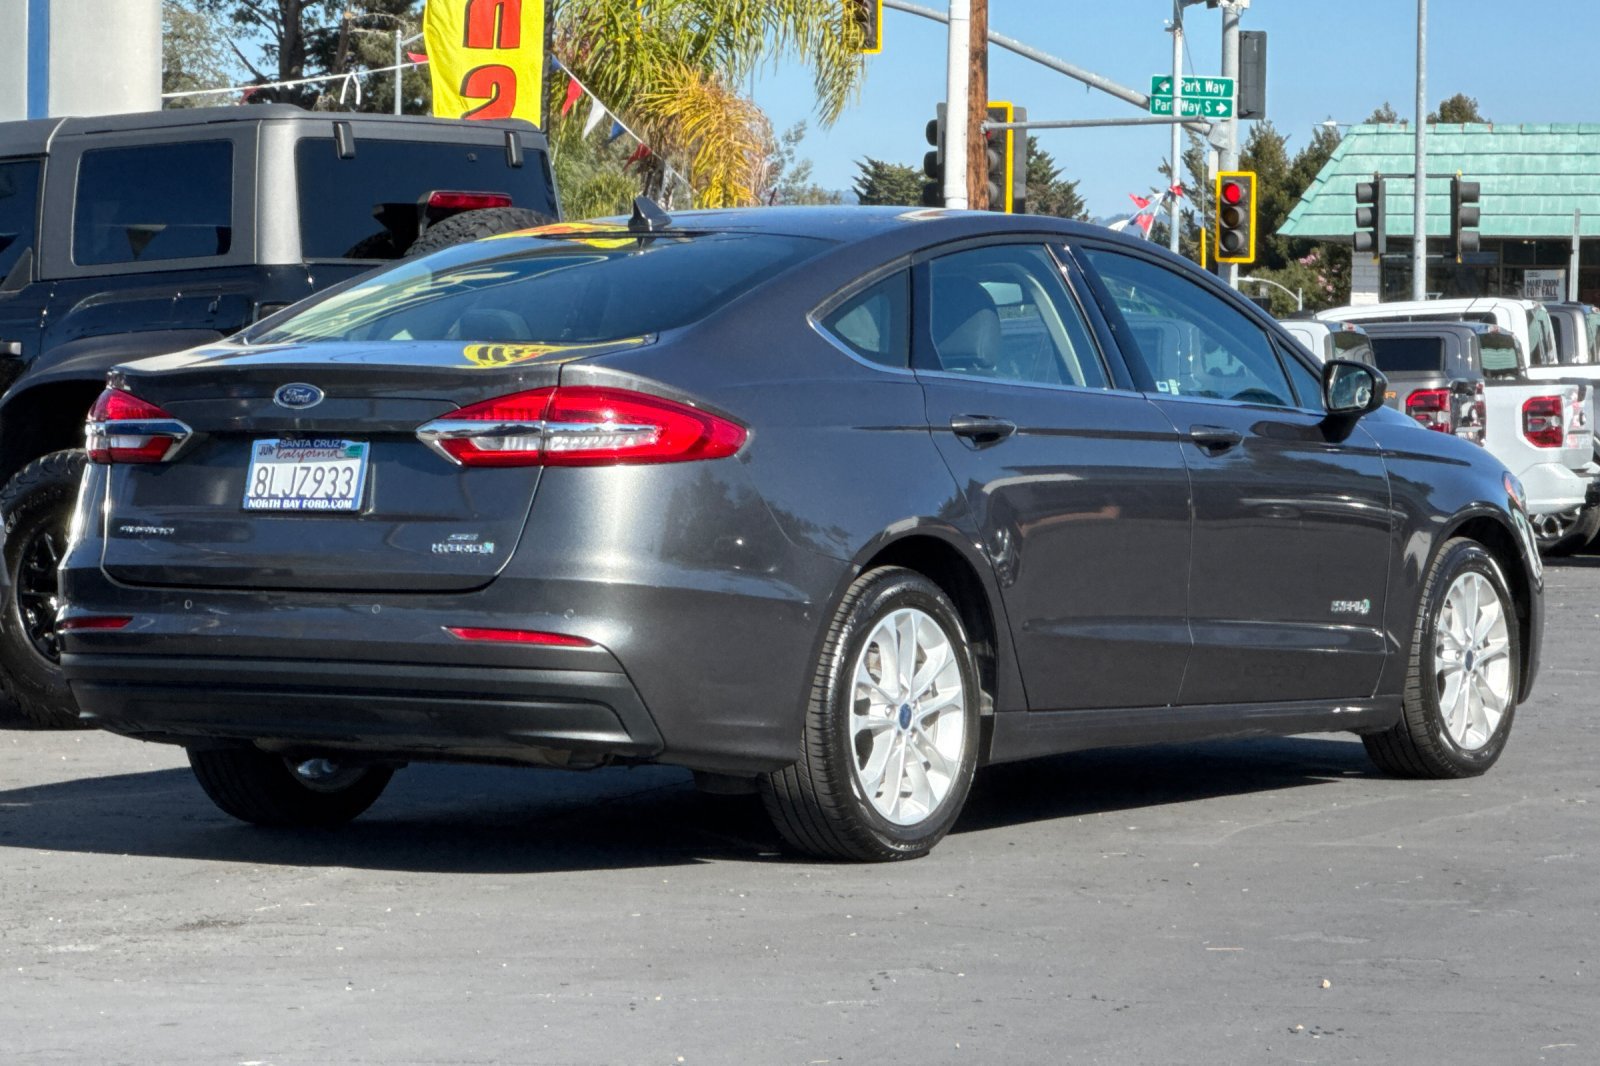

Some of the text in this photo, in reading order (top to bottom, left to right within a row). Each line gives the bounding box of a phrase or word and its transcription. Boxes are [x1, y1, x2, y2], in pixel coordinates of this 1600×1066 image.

[1181, 80, 1225, 96] Park Way
[1155, 98, 1211, 114] Par Way S
[282, 388, 312, 403] Ford
[280, 440, 340, 448] SANTA CRUZ
[276, 445, 343, 463] California
[254, 466, 354, 498] 8LJZ933
[248, 499, 353, 509] NORTH BAY FORD.COM
